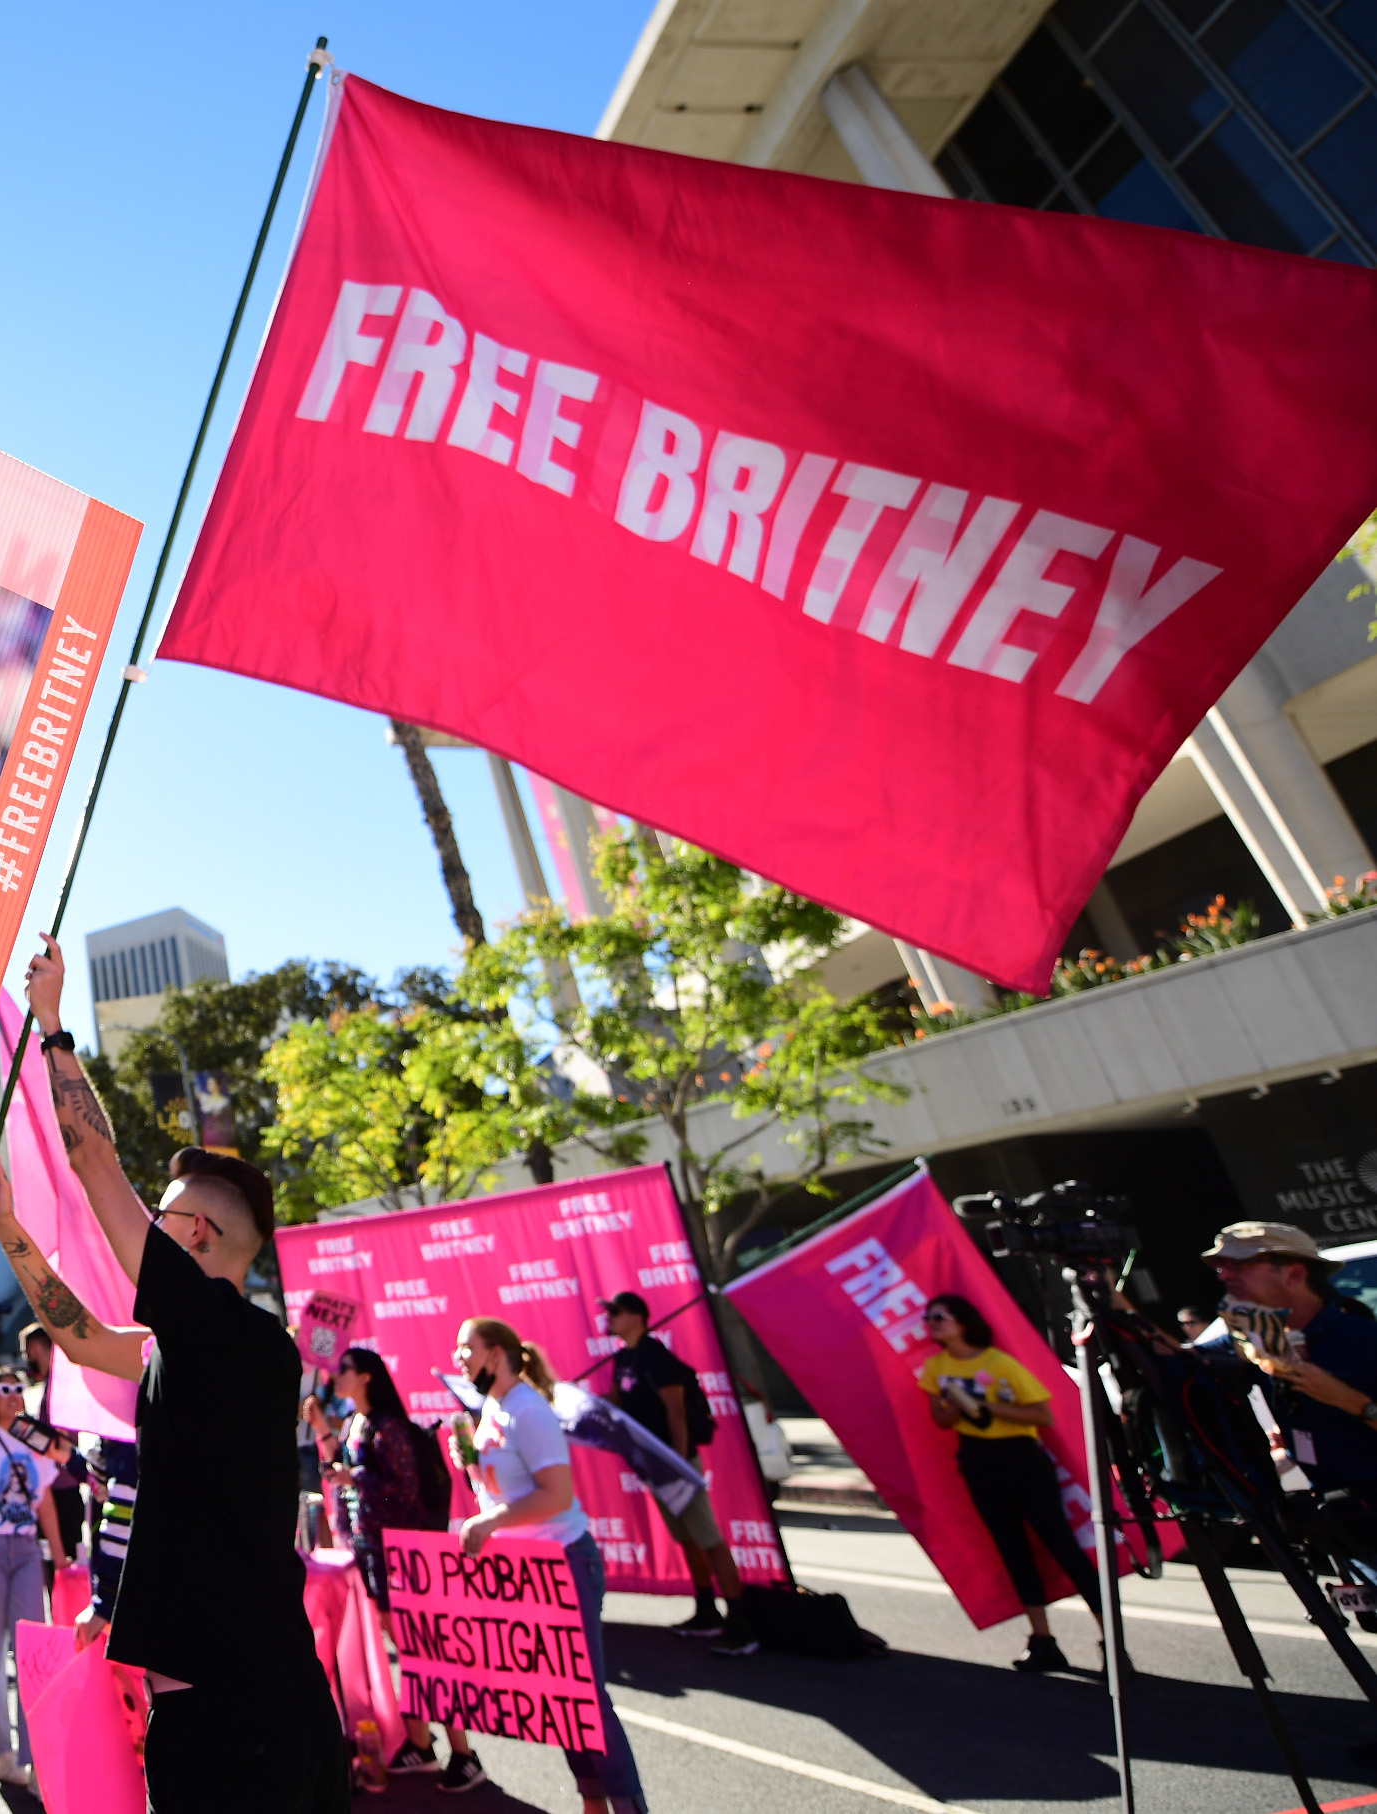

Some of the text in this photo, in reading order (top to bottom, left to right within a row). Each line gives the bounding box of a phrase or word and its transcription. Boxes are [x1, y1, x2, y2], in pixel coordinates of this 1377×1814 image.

[295, 280, 1223, 705] FREE BRITNEY
[1296, 1157, 1353, 1183] THE
[559, 1192, 612, 1218] FREE
[1276, 1182, 1365, 1213] MUSIC
[429, 1218, 474, 1240] FREE
[549, 1211, 633, 1241] BRITNEY
[316, 1236, 355, 1255] FREE
[420, 1234, 496, 1261] BRITNEY
[308, 1252, 372, 1275] BRITNEY
[508, 1259, 559, 1282] FREE
[384, 1279, 429, 1298] FREE
[498, 1278, 579, 1305] BRITNEY
[824, 1236, 928, 1354] FREE
[306, 1303, 352, 1330] NEXT
[374, 1297, 448, 1319] BRITNEY
[386, 1546, 578, 1611] END PROBATE
[392, 1606, 592, 1684] INVESTIGATE
[400, 1670, 608, 1757] INCARCERATE
